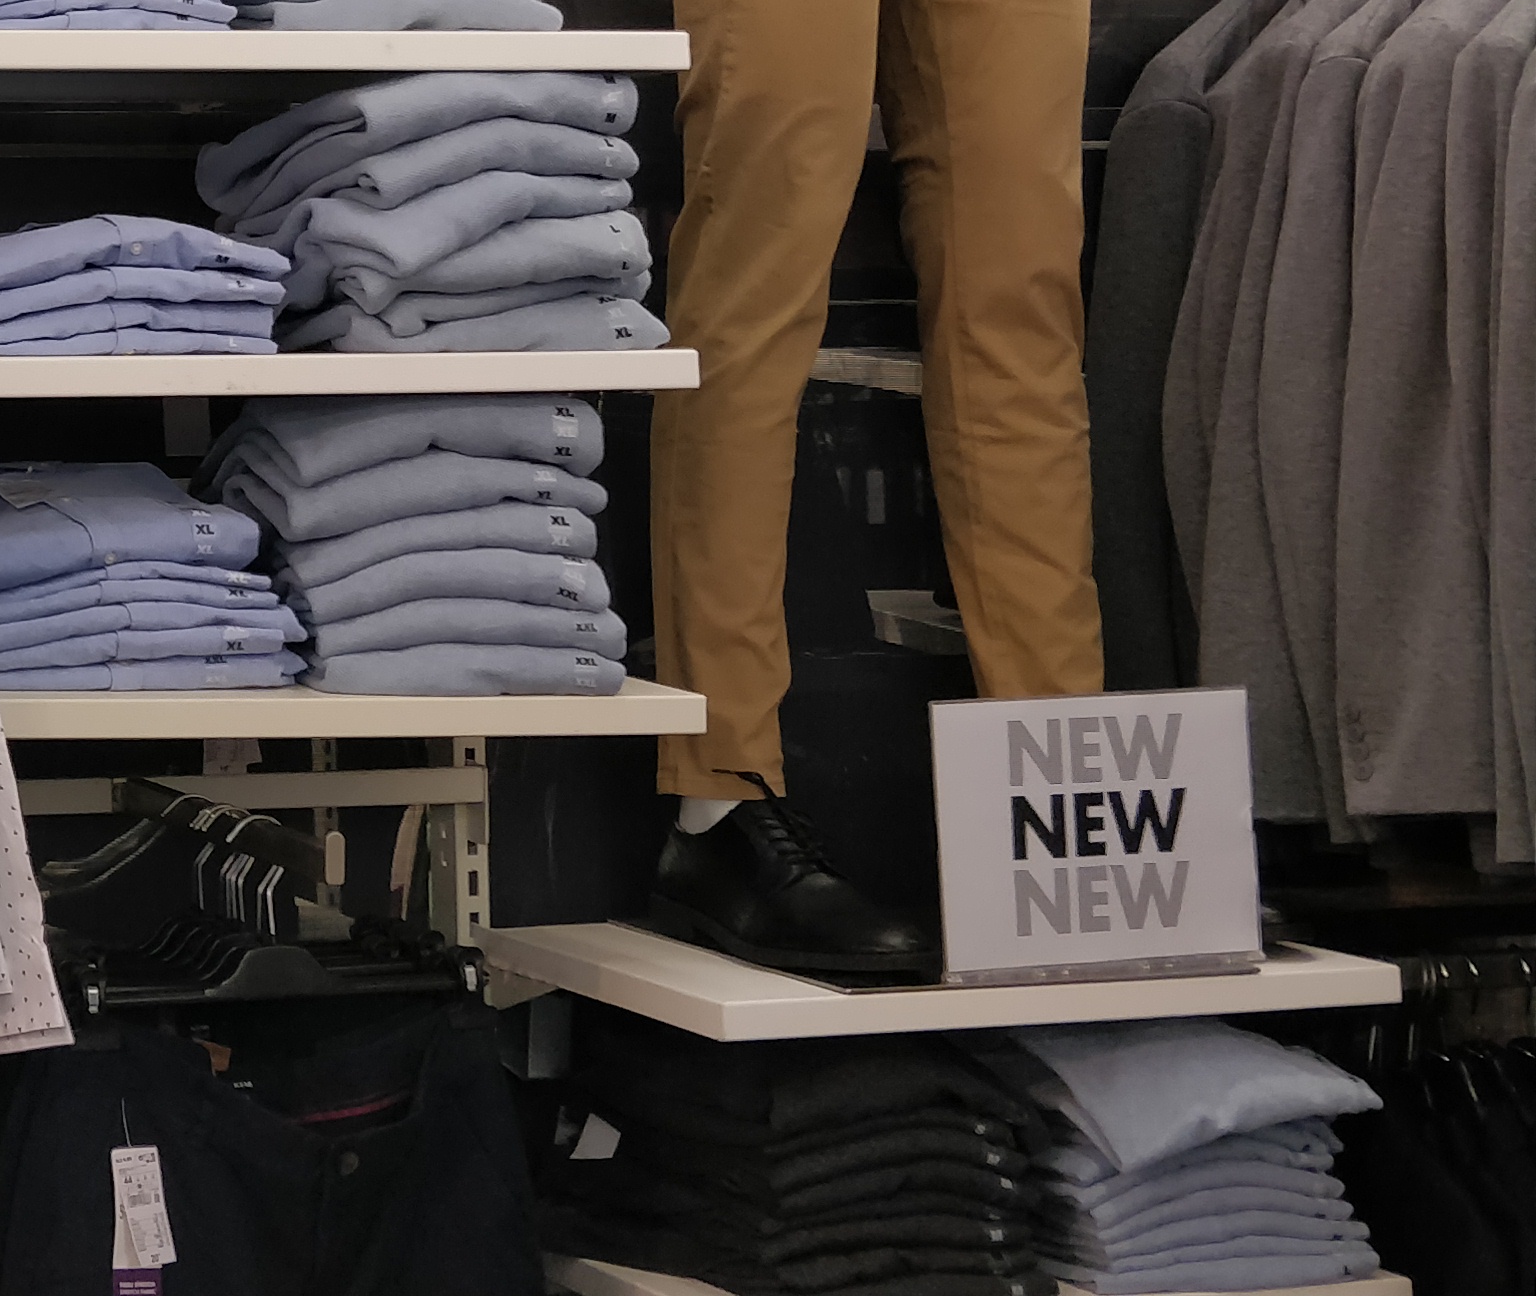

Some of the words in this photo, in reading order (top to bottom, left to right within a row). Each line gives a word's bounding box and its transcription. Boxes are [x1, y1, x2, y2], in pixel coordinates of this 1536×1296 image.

[614, 327, 632, 339] XL
[555, 406, 575, 417] XL
[554, 446, 573, 457] XL
[550, 515, 570, 526] XL
[195, 524, 215, 535] XL
[197, 544, 214, 555] XL
[227, 641, 245, 651] XL
[575, 657, 598, 667] XXL
[1007, 712, 1183, 787] NEW
[1010, 787, 1188, 862] NEW
[1013, 860, 1190, 937] NEW
